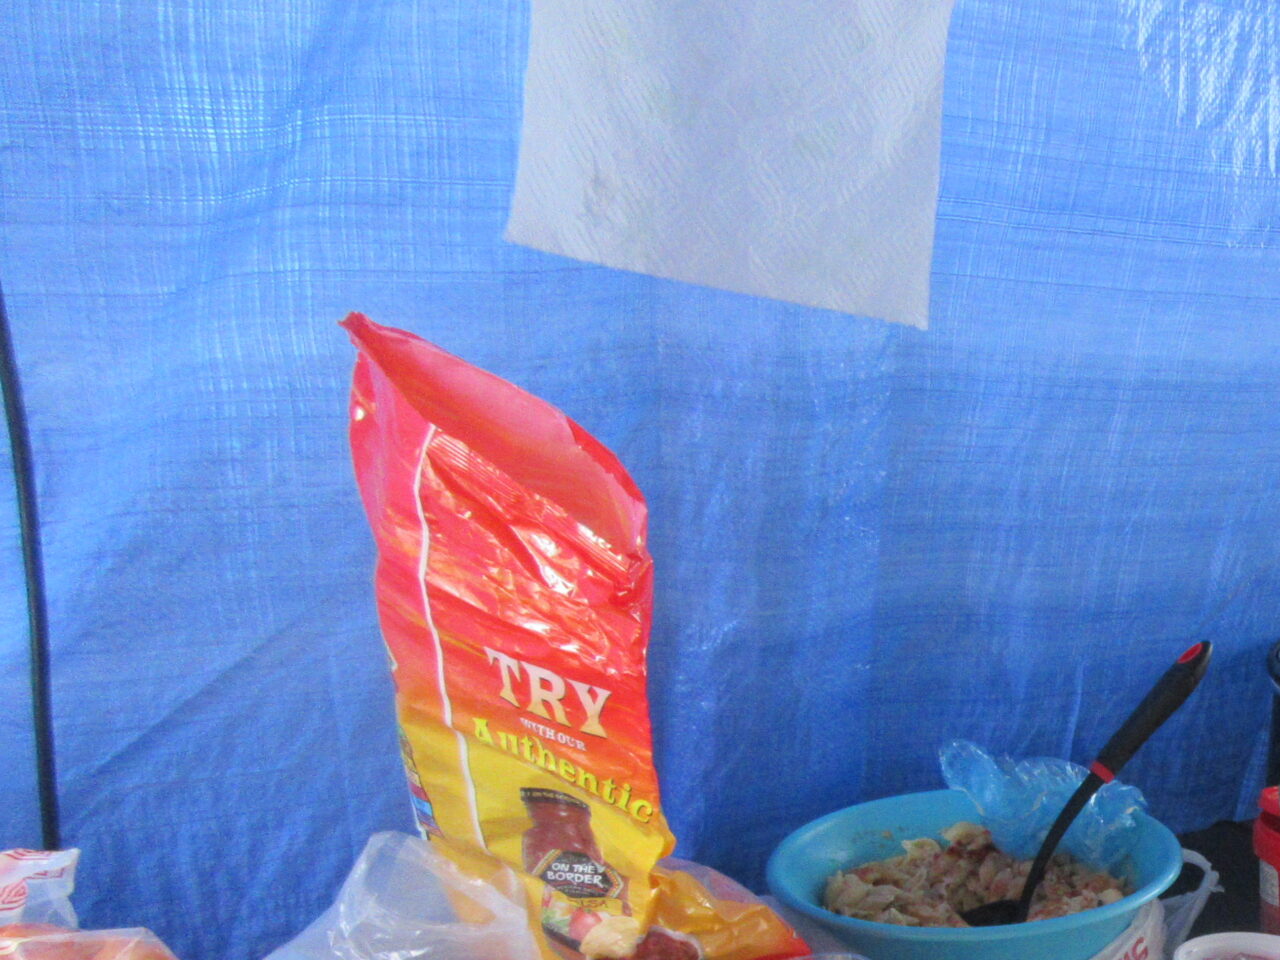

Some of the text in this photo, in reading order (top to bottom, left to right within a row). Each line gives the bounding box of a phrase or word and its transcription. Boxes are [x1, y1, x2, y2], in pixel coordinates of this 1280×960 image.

[483, 646, 612, 739] TRY
[520, 717, 588, 752] WITH OUR
[472, 717, 655, 824] Authentic
[546, 870, 604, 888] BORDER
[551, 862, 595, 874] ON THE
